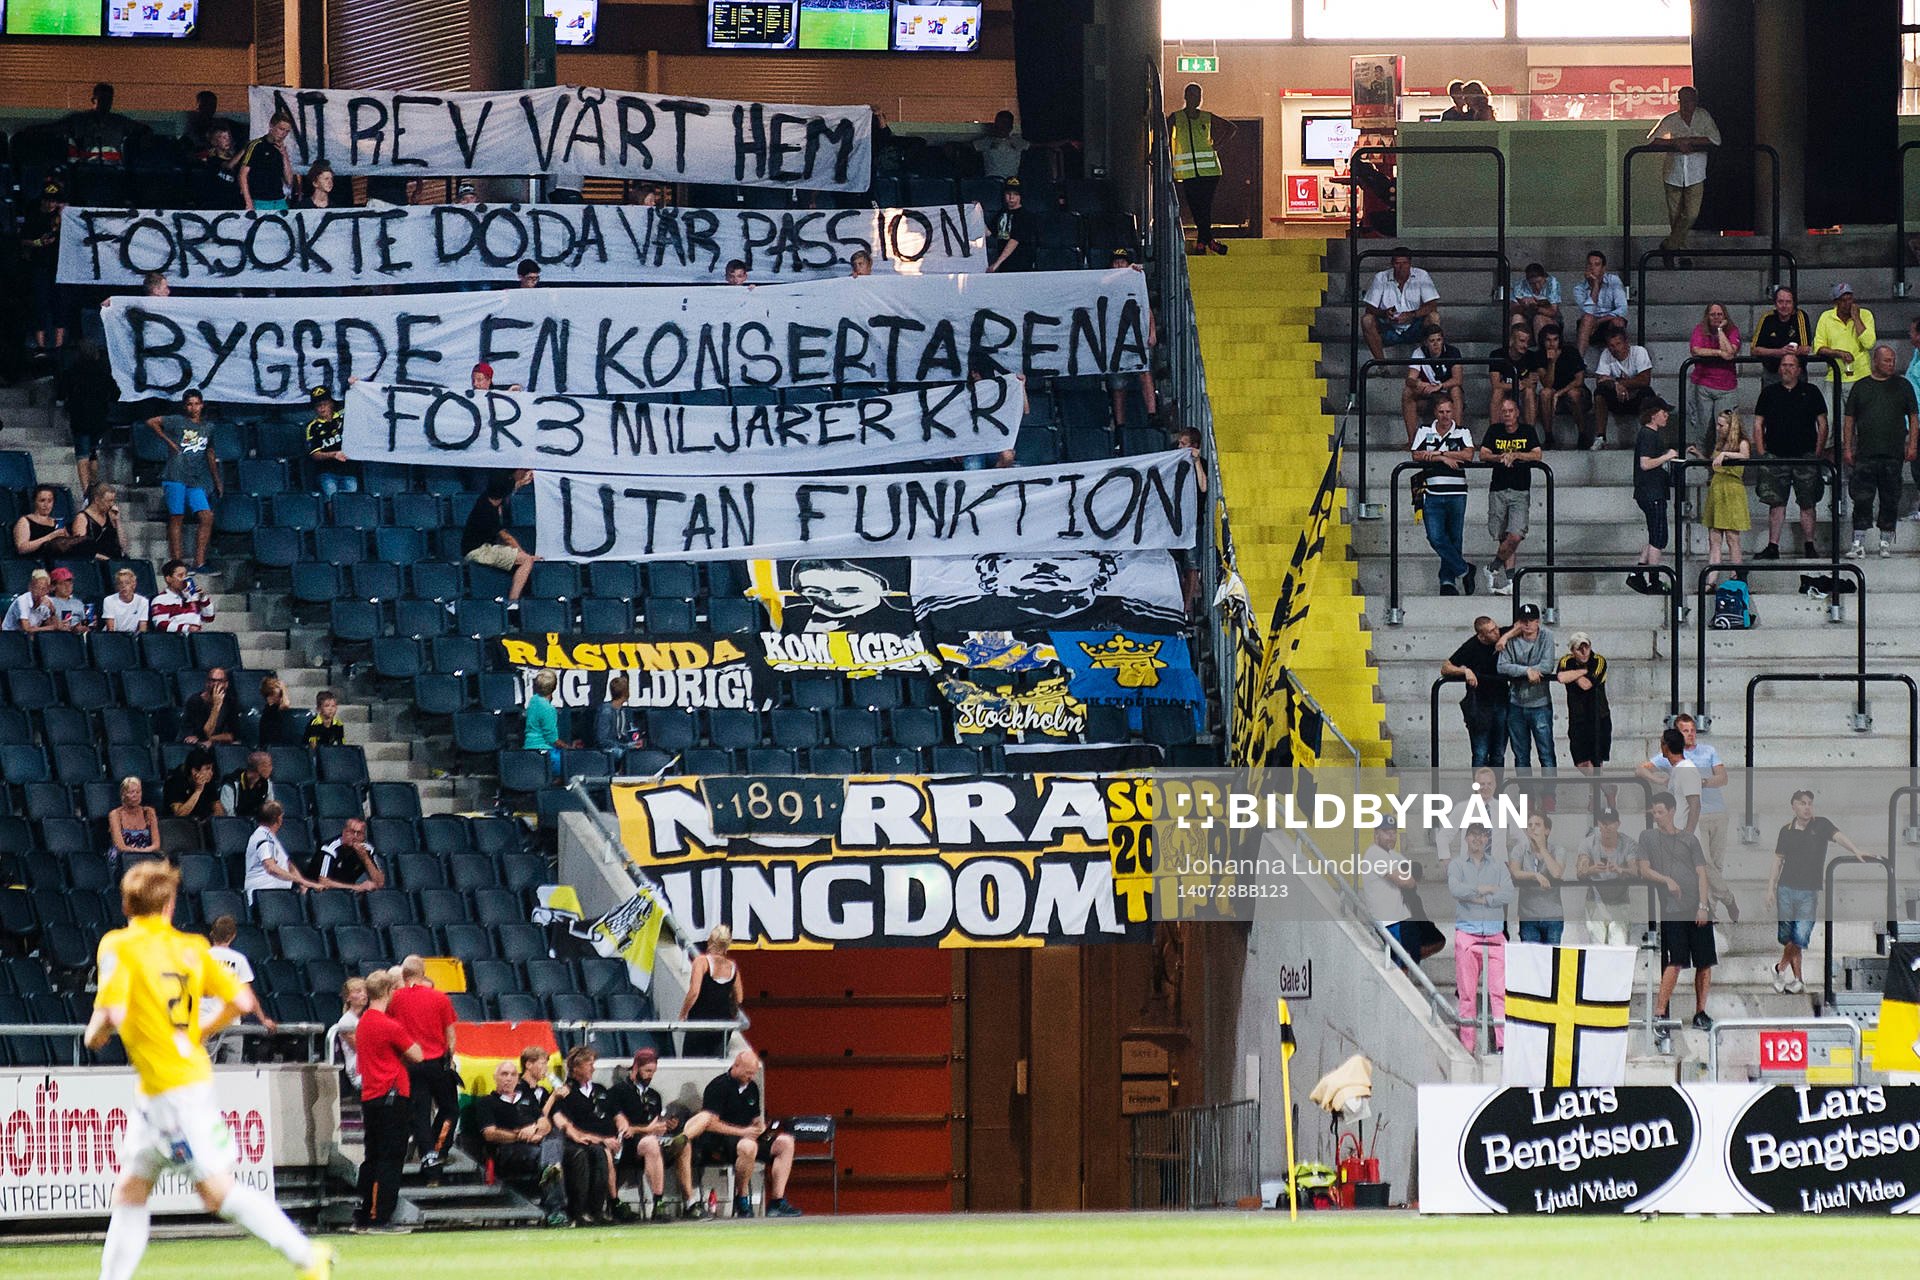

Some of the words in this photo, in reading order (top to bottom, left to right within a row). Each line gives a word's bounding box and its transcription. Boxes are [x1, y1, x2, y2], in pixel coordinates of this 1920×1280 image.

[1610, 78, 1681, 112] Spela
[273, 89, 326, 166] NI
[348, 95, 493, 170] REV
[519, 85, 710, 174] VÅRT
[732, 102, 854, 184] HEM
[80, 207, 414, 280] FÖRSÖKTE
[430, 203, 608, 268] DÖDA
[617, 204, 720, 272] VÅR
[736, 203, 971, 274] PASSION
[126, 306, 443, 398] BYGGDE
[479, 313, 570, 393] EN
[596, 295, 1149, 396] KONSERTARENA
[384, 384, 522, 452] FÖR
[535, 394, 585, 457] 3
[611, 396, 896, 456] MILJARER
[917, 375, 1010, 442] KR
[560, 476, 756, 558] UTAN
[795, 460, 1192, 546] FUNKTION
[501, 632, 746, 672] RÅSUNDA
[760, 632, 834, 664] KOM
[848, 631, 926, 664] IGEN
[956, 703, 1085, 733] Stockholm
[643, 781, 1110, 854] NRRA
[1107, 779, 1232, 822] SÖDR
[660, 860, 1126, 943] UNGDOM
[1280, 965, 1299, 992] Gate
[1302, 965, 1307, 991] 3
[1765, 1038, 1803, 1062] 123
[1528, 1085, 1619, 1125] Lars
[1794, 1085, 1887, 1124] Lars
[1480, 1116, 1678, 1176] Bengtsson
[1745, 1117, 1920, 1176] Bengtsso
[1534, 1178, 1638, 1214] Ljud/Video
[1800, 1178, 1906, 1214] Ljud/Video
